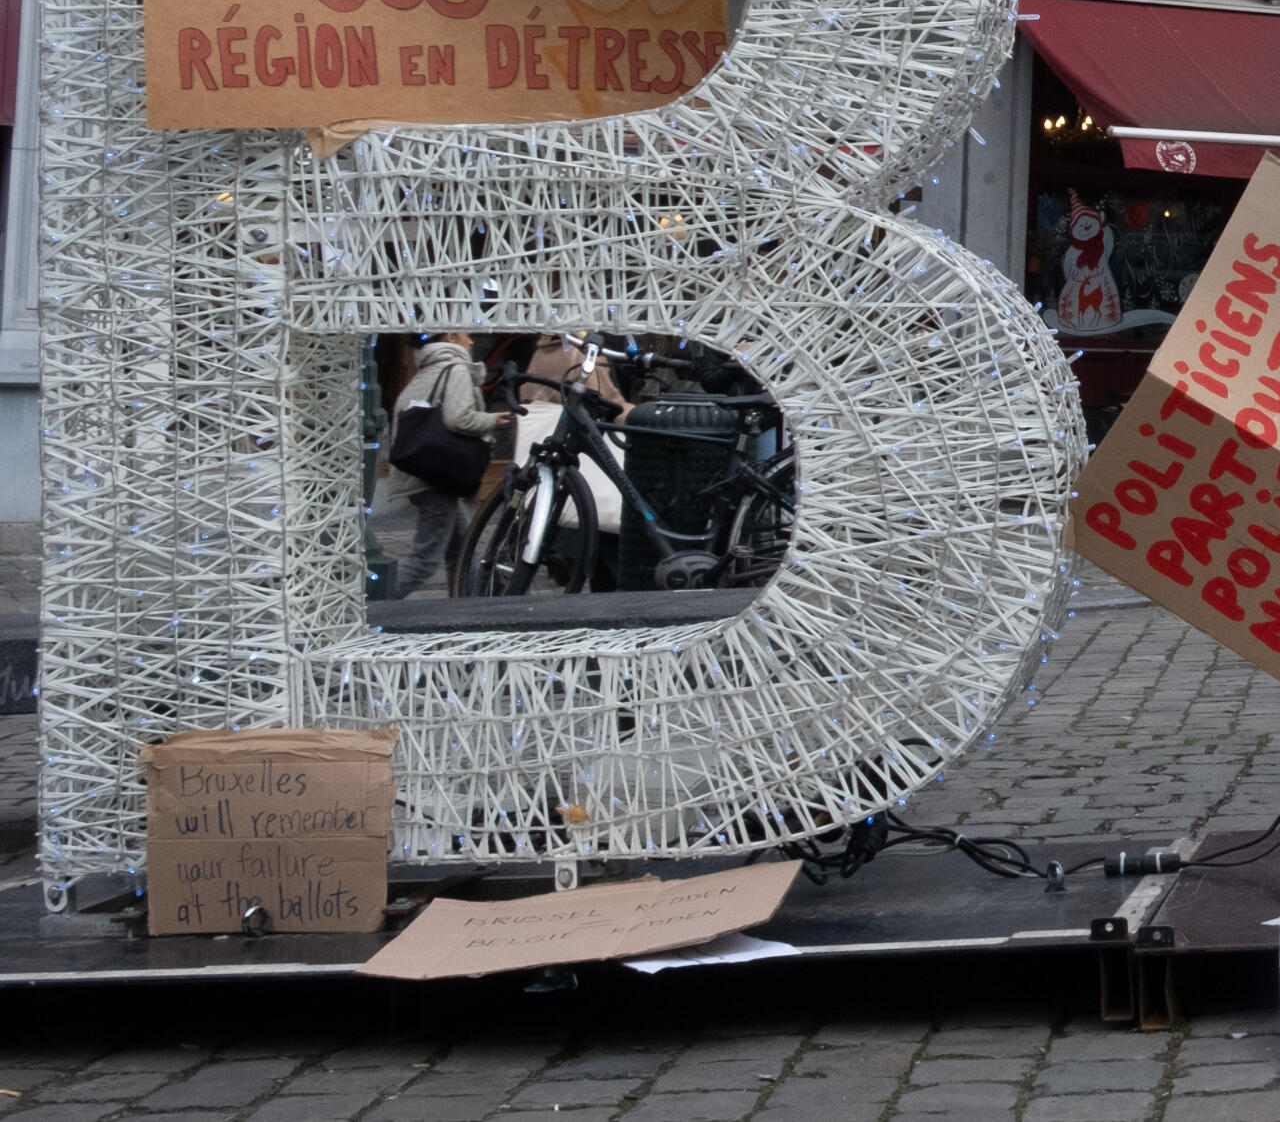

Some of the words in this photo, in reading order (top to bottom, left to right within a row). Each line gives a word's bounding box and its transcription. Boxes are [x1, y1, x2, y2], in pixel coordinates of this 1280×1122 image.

[401, 45, 456, 86] EN
[485, 6, 727, 95] DÉTRESSE
[180, 758, 307, 797] Bruxelles
[176, 799, 234, 838] will
[252, 801, 378, 838] remember
[178, 857, 226, 886] your
[238, 843, 336, 878] failure
[178, 893, 205, 925] at
[279, 880, 358, 923] ballots
